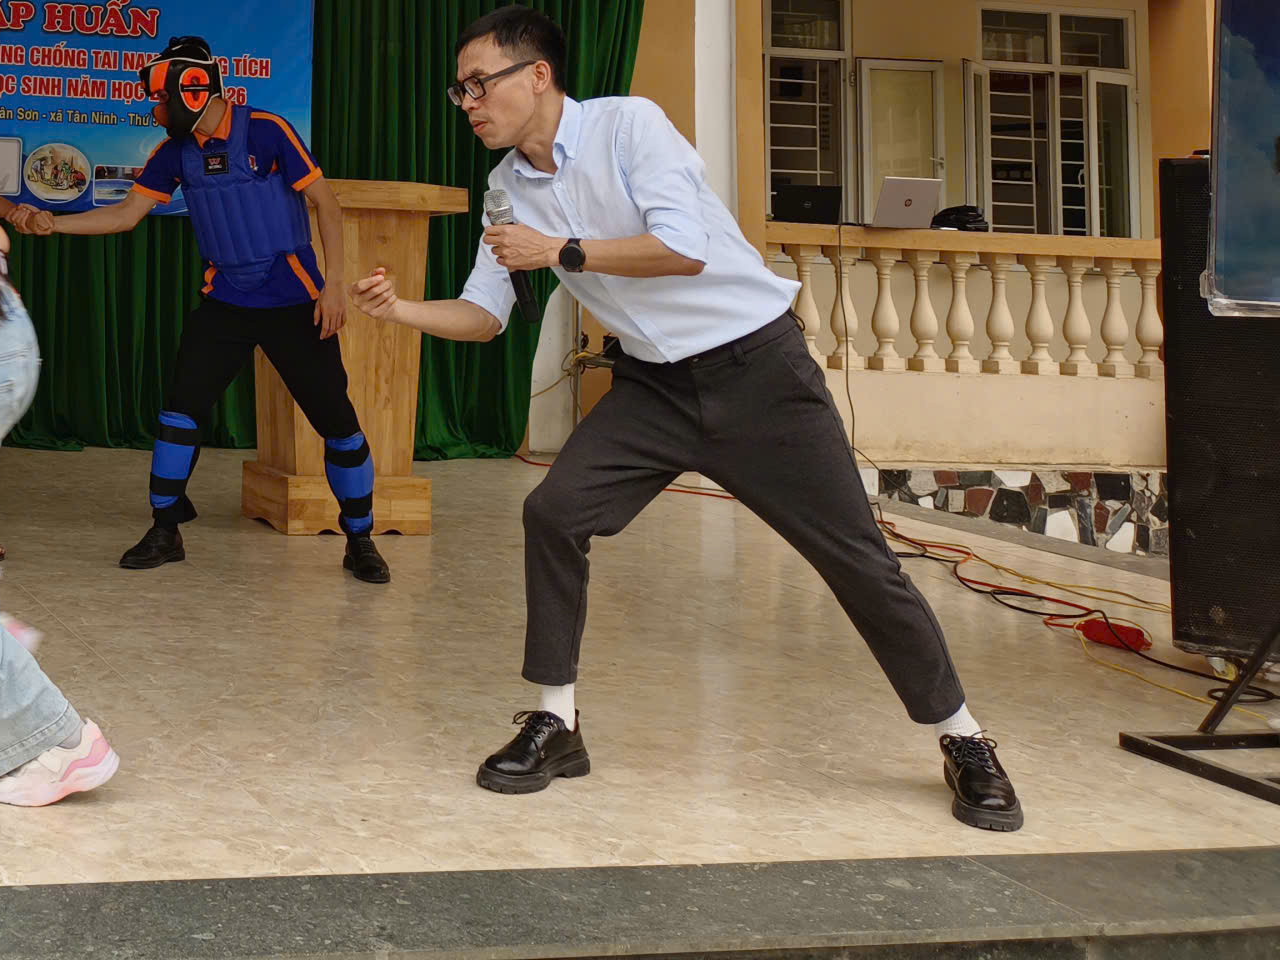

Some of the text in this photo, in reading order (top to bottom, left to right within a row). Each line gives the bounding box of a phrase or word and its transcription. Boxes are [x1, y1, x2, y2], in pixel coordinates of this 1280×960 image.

[29, 40, 88, 70] CHỐNG
[91, 49, 118, 70] TAI
[232, 52, 271, 79] TÍCH
[21, 74, 63, 97] SINH
[67, 75, 108, 100] NĂM
[110, 79, 146, 105] HỌC
[17, 107, 39, 121] Sơn
[50, 109, 63, 122] xã
[66, 110, 88, 123] Tân
[91, 111, 117, 125] Ninh
[128, 113, 151, 126] Thứ
